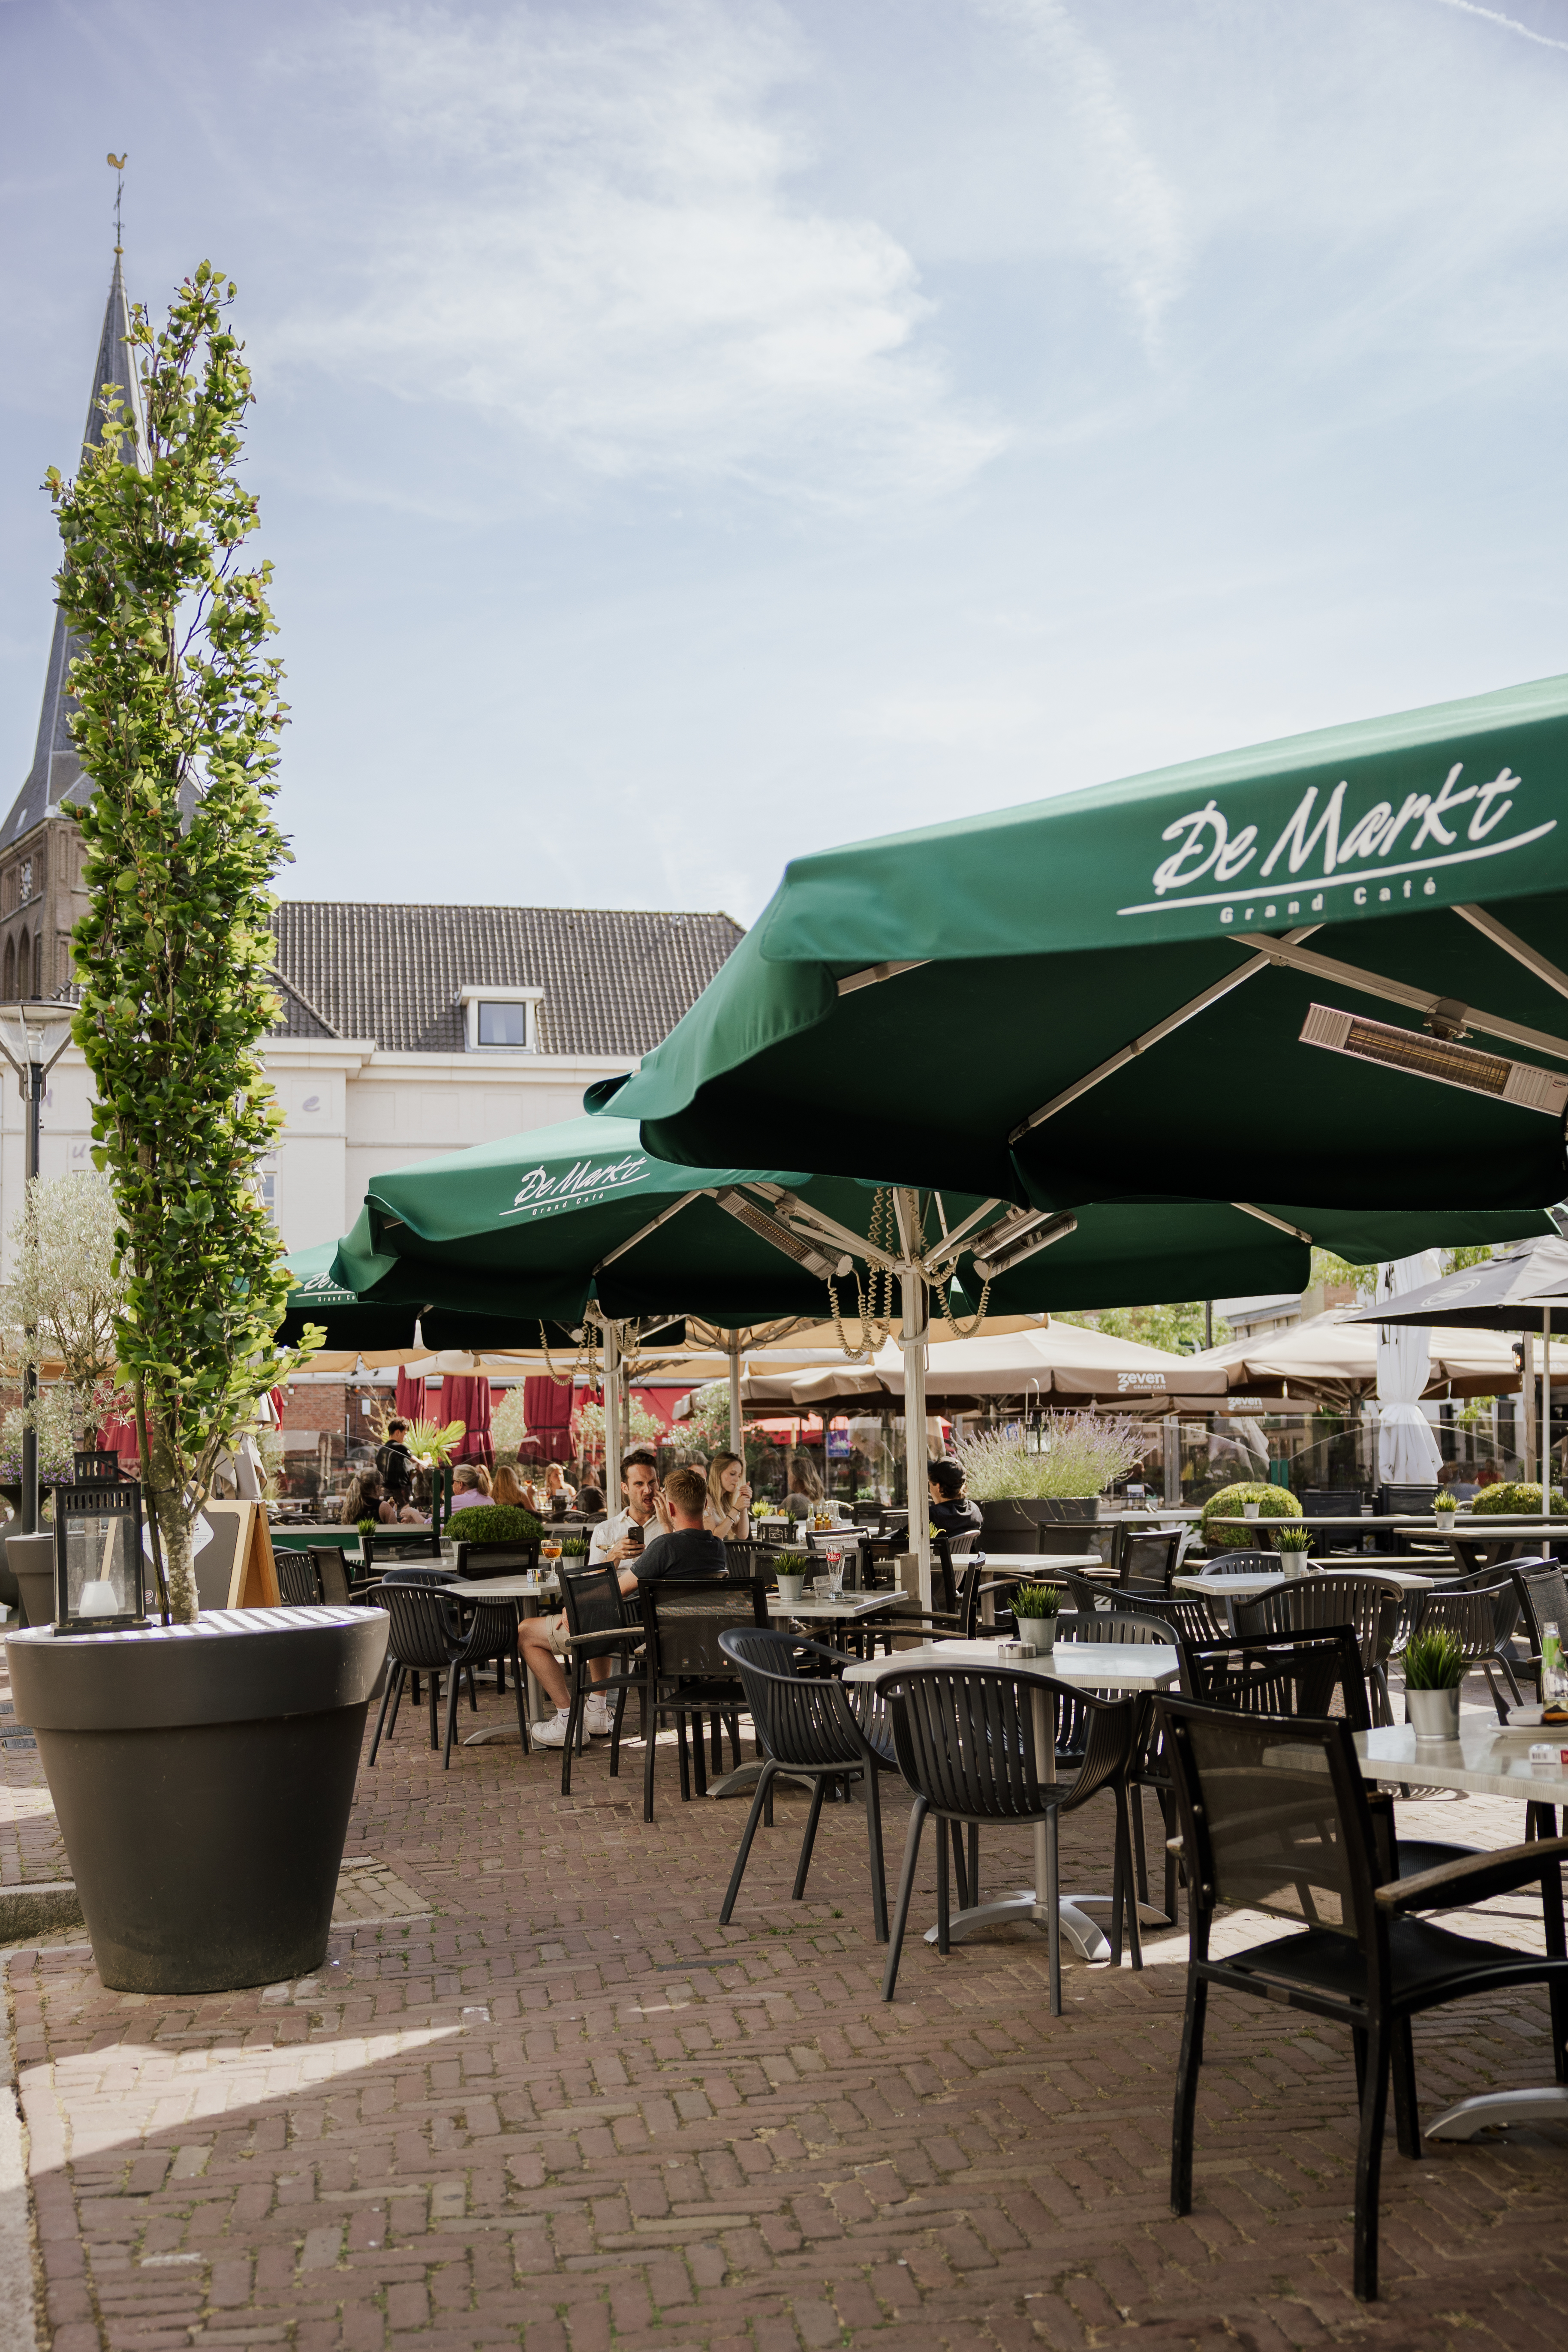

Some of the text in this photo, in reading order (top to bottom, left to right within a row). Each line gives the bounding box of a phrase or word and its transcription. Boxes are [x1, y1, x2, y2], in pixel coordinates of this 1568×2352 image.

[1153, 762, 1522, 895] De Markt
[1220, 876, 1436, 923] Grand Café
[514, 1155, 647, 1206] De Markt
[532, 1192, 604, 1216] Grand Café
[304, 1271, 331, 1292] De
[1117, 1373, 1166, 1392] zeven
